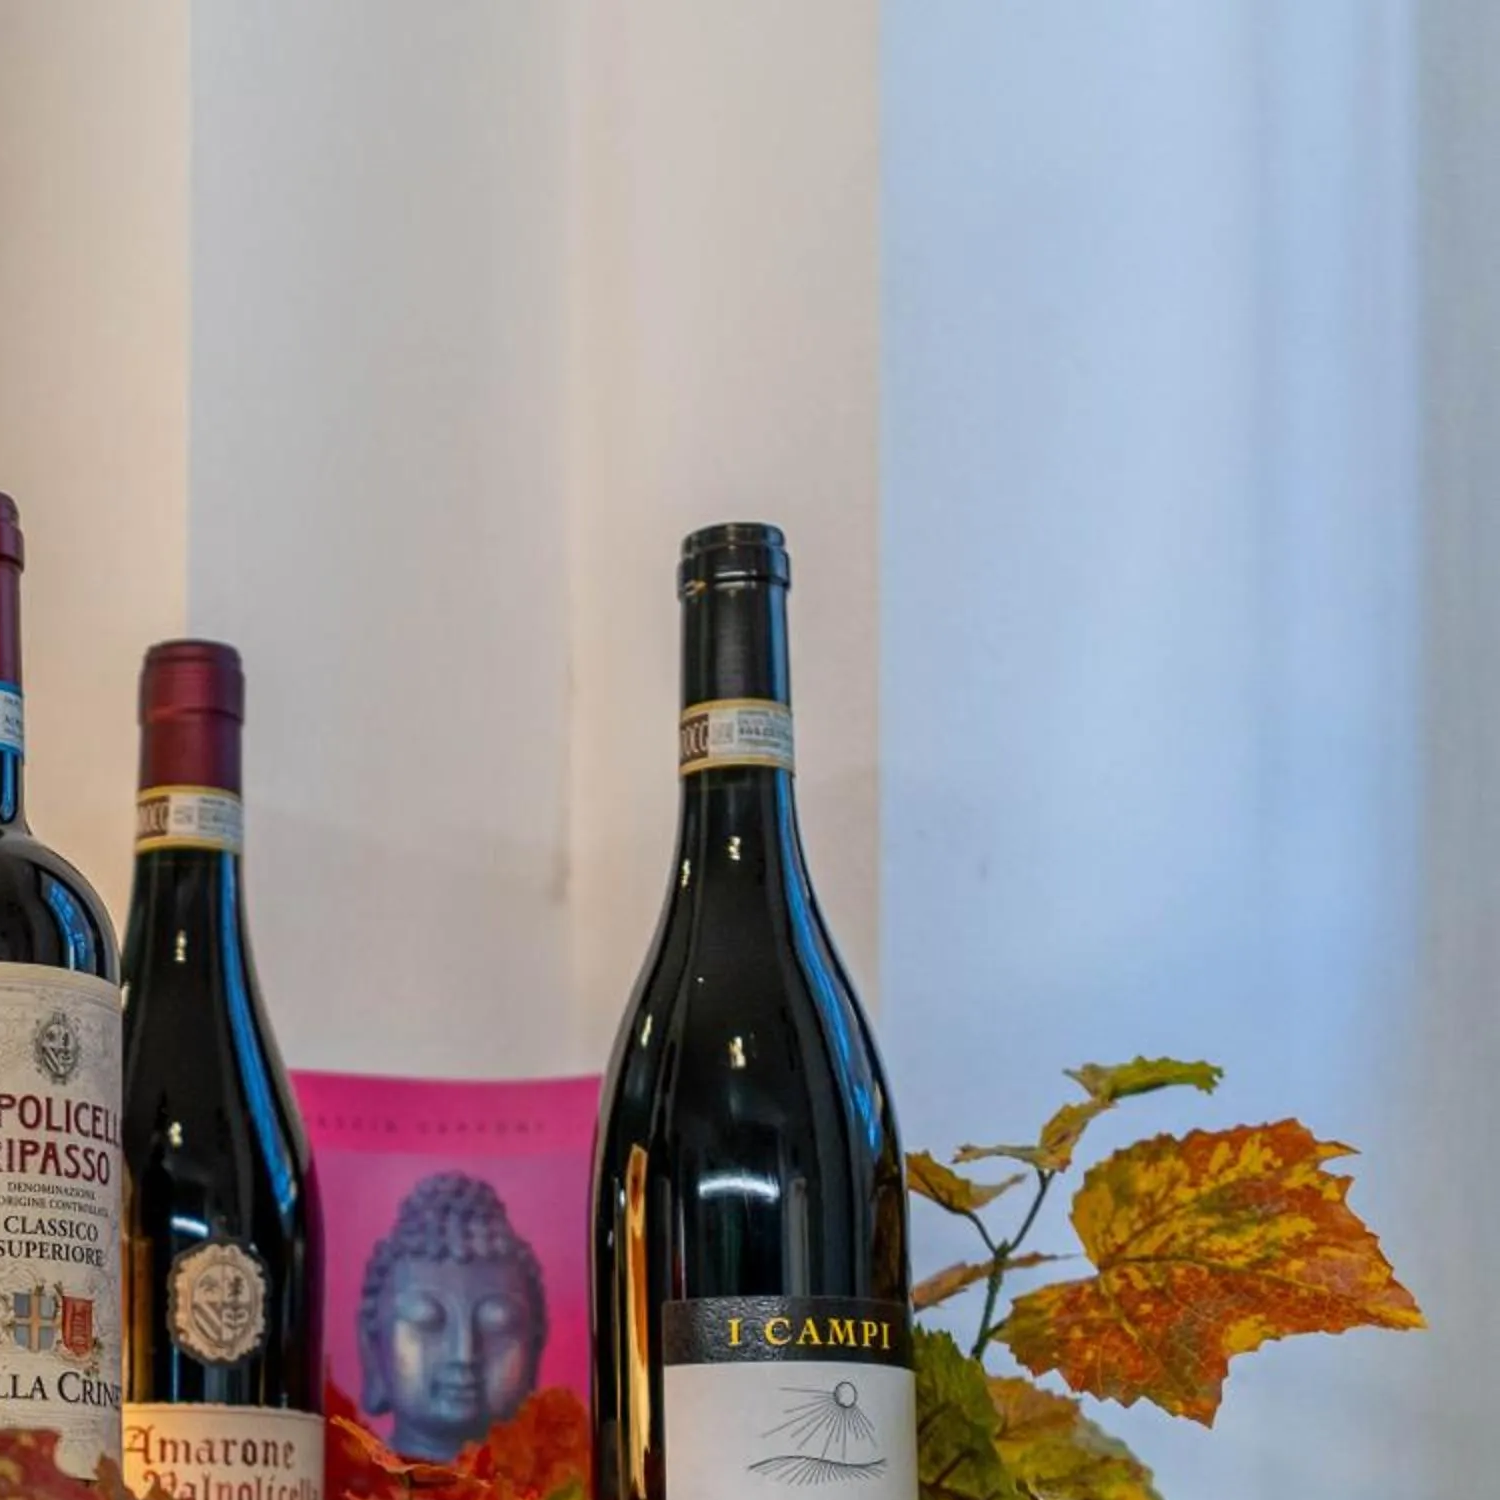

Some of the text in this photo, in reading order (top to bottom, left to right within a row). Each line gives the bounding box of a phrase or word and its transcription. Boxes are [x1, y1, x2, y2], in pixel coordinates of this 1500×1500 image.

[3, 1215, 99, 1242] CLASSICO
[727, 1317, 891, 1350] I CAMPI
[124, 1423, 297, 1471] Amarone
